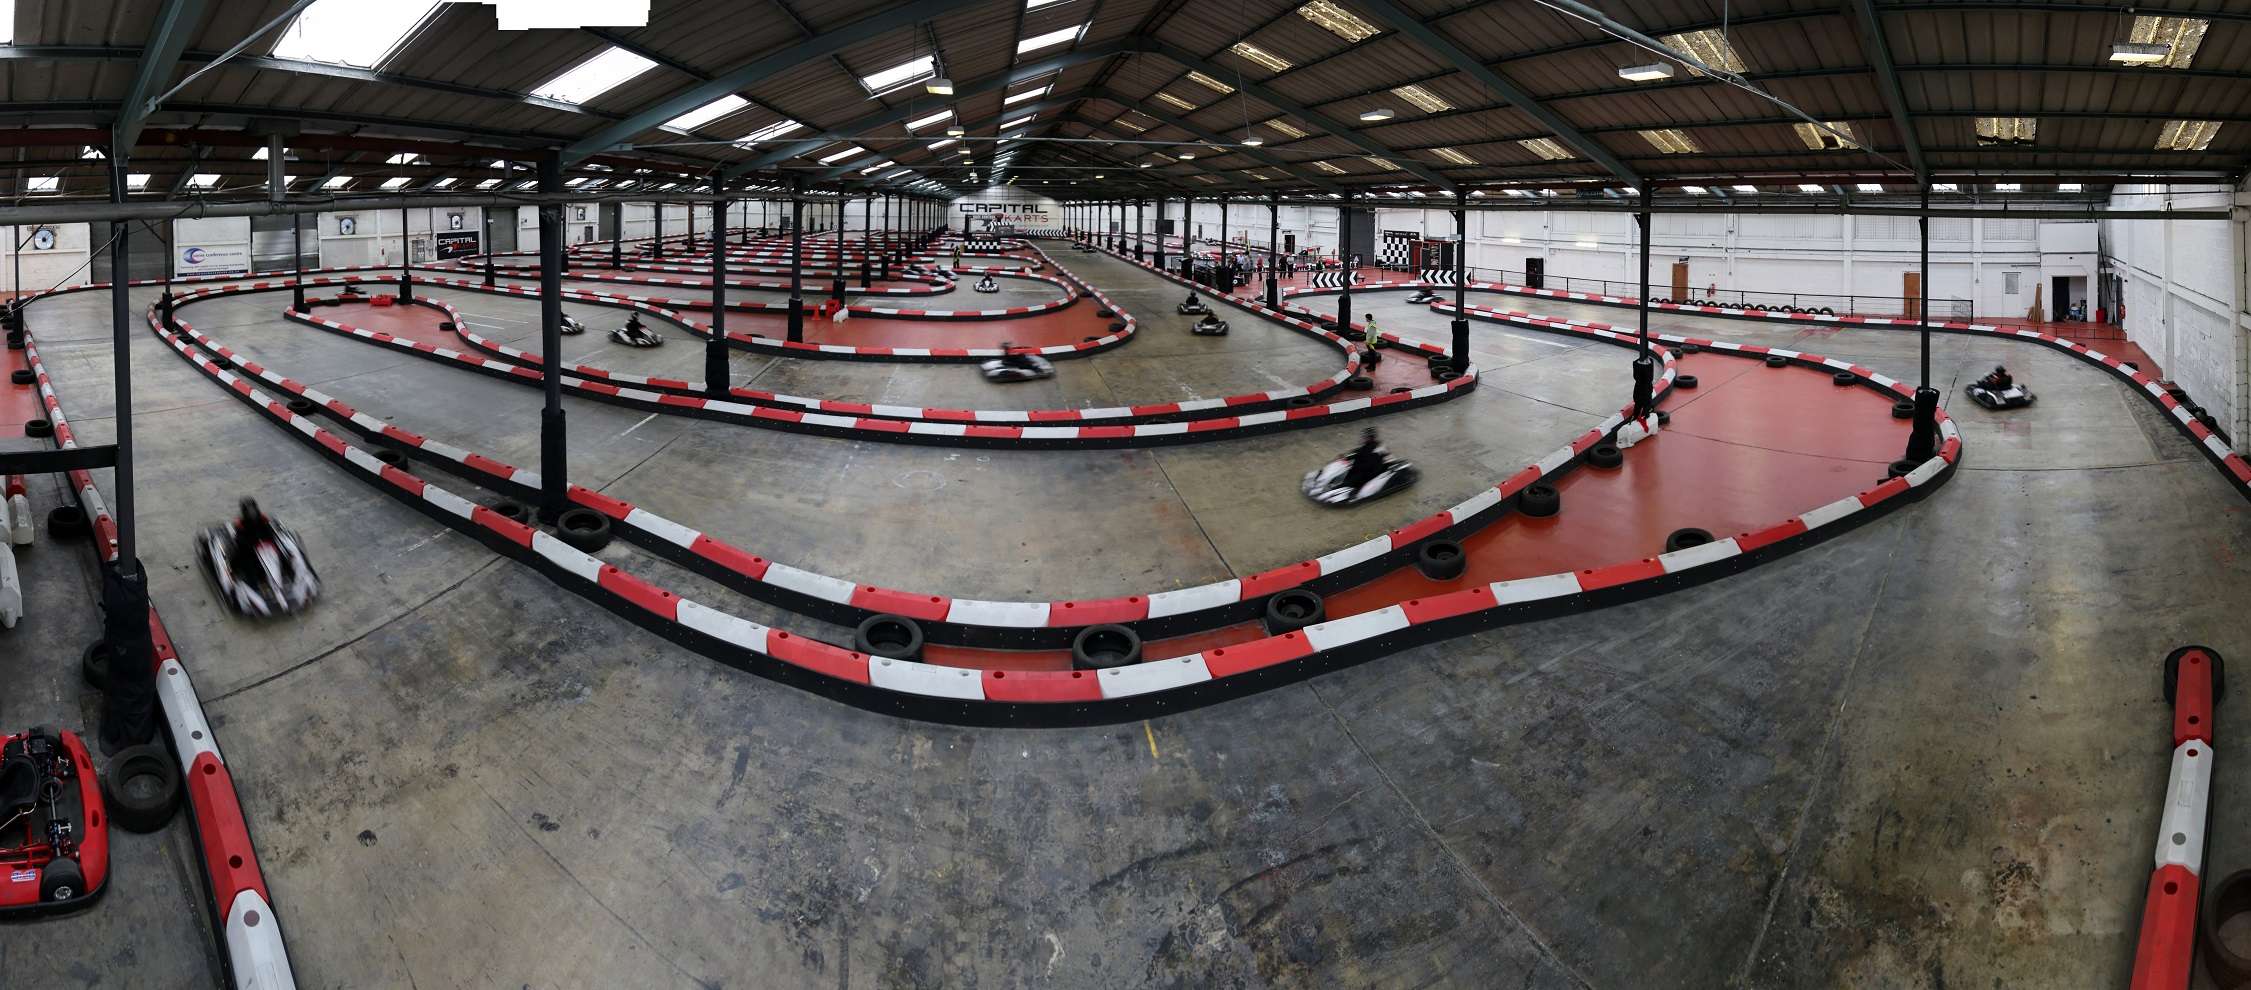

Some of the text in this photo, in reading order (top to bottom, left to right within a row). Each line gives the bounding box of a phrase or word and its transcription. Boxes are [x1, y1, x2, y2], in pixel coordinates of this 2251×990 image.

[960, 204, 1048, 213] CAPITAL
[1004, 214, 1049, 222] KARTS
[438, 237, 477, 245] CAPITAL
